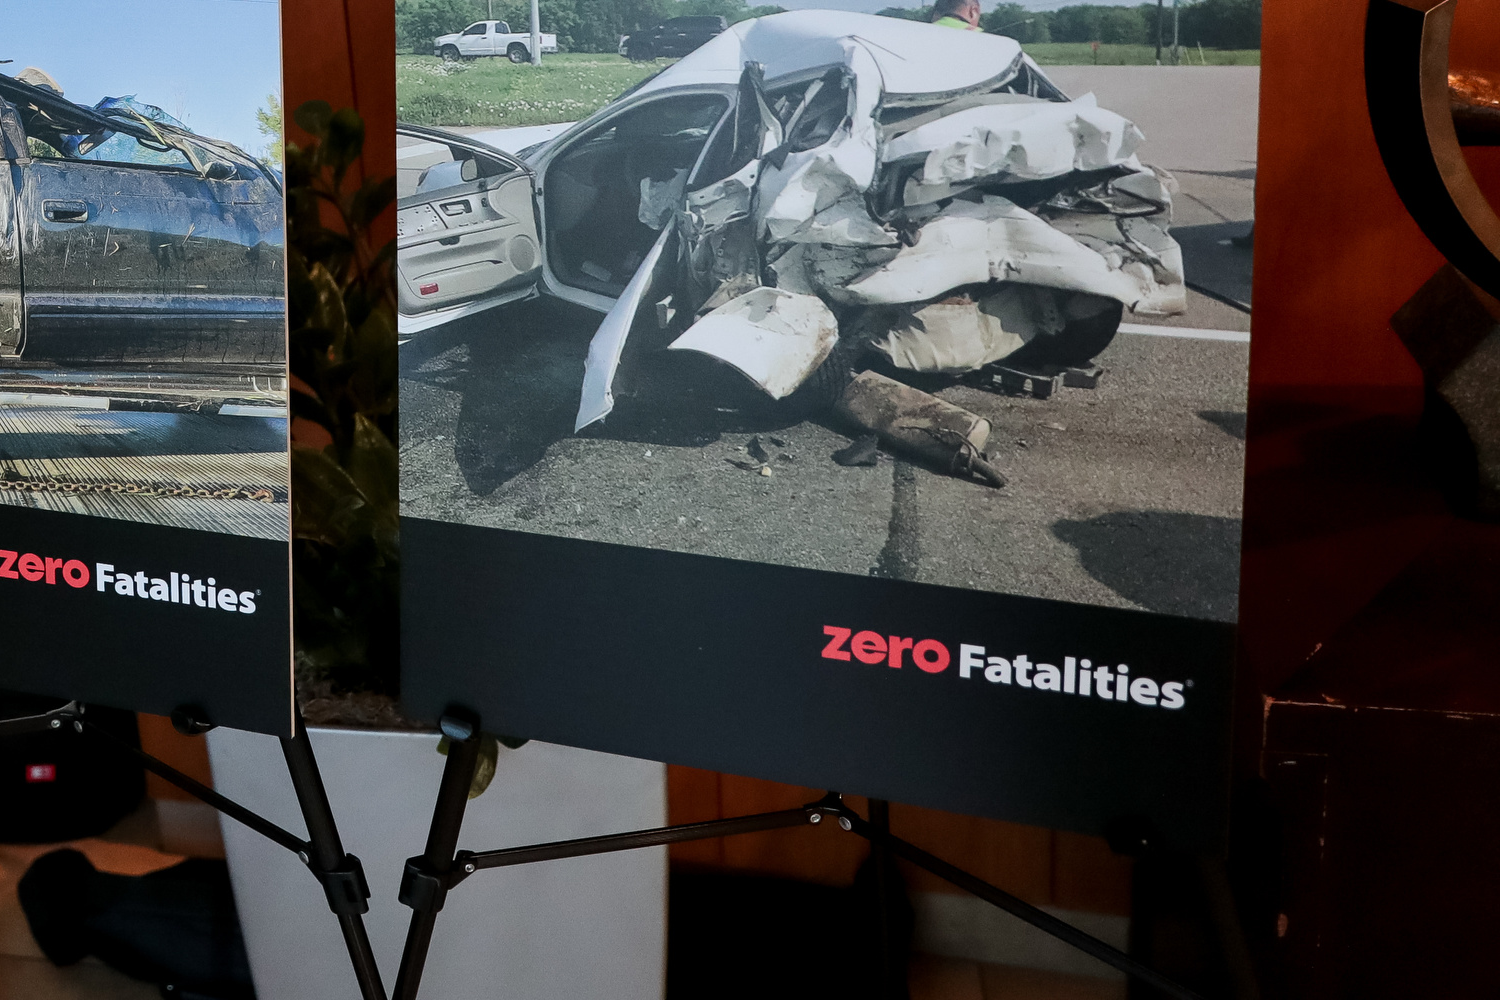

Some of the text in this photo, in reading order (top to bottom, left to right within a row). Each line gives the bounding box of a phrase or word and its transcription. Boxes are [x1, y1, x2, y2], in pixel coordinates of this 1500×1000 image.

[96, 562, 257, 614] Fatalities
[821, 625, 1185, 709] zero Fatalities
